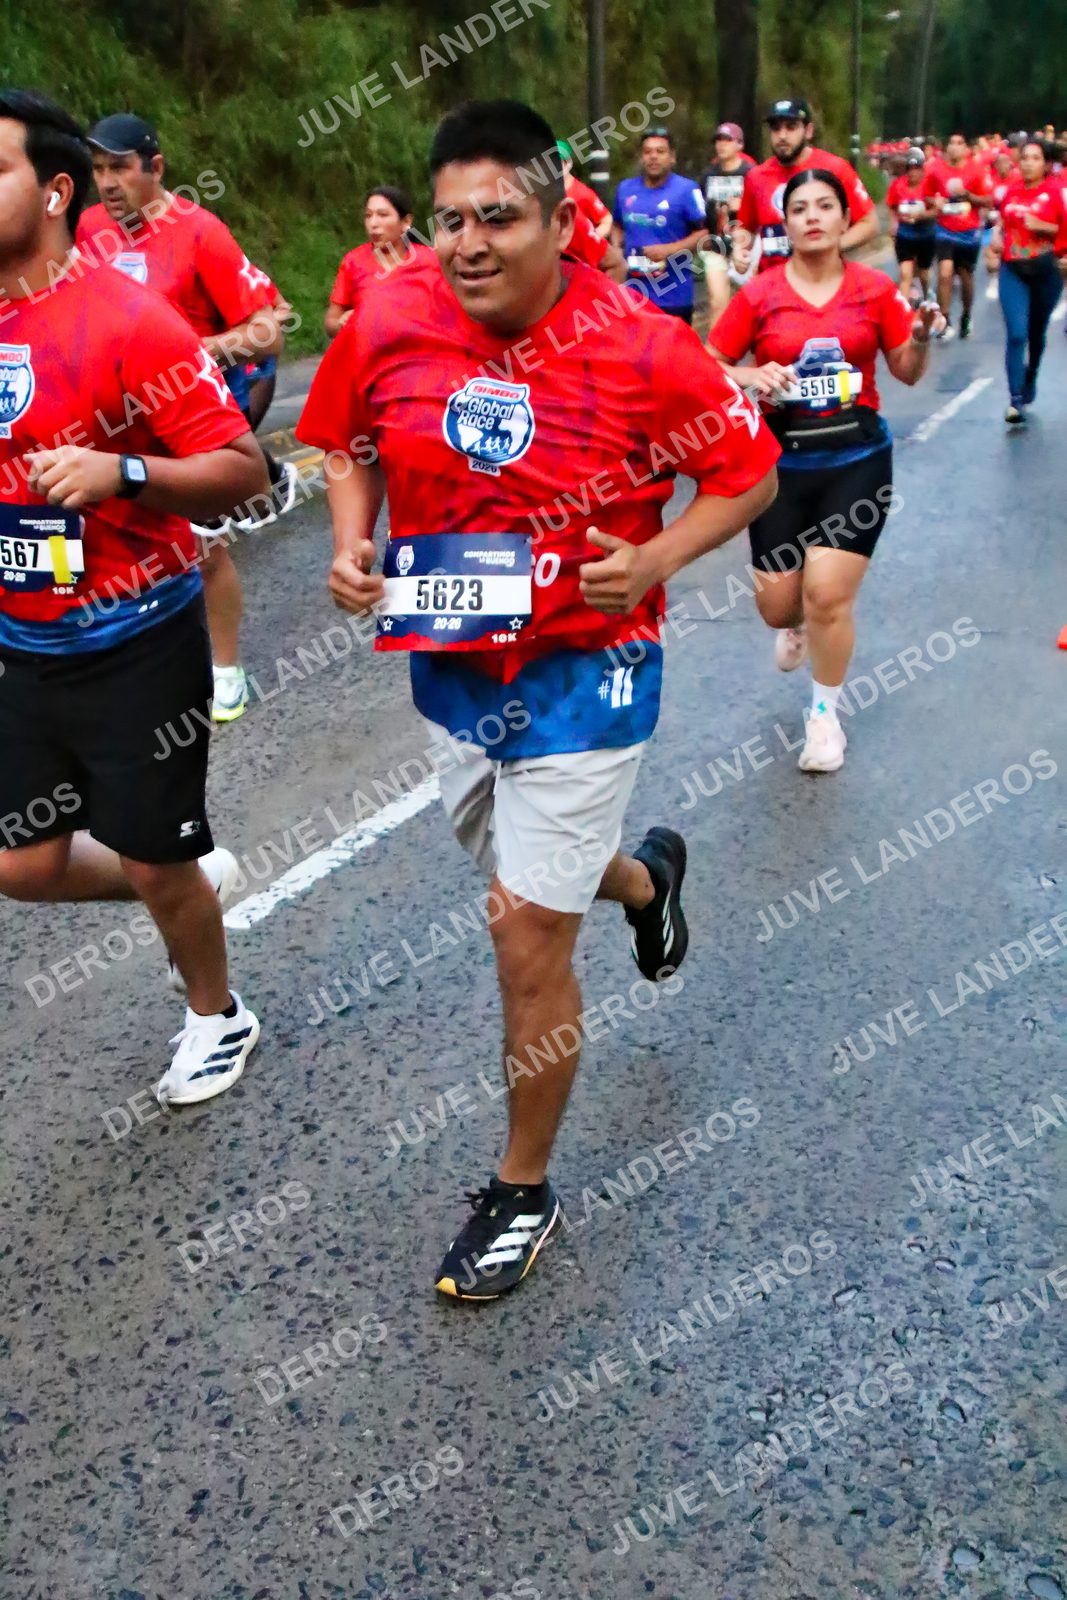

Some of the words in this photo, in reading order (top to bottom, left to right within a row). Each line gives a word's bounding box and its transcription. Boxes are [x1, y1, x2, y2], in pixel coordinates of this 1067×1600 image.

[474, 385, 520, 399] BIMBO
[468, 397, 514, 419] Global
[459, 411, 494, 430] Race
[472, 461, 498, 473] 2026
[0, 538, 38, 568] 567
[416, 578, 484, 612] 5623
[492, 632, 518, 644] 10K
